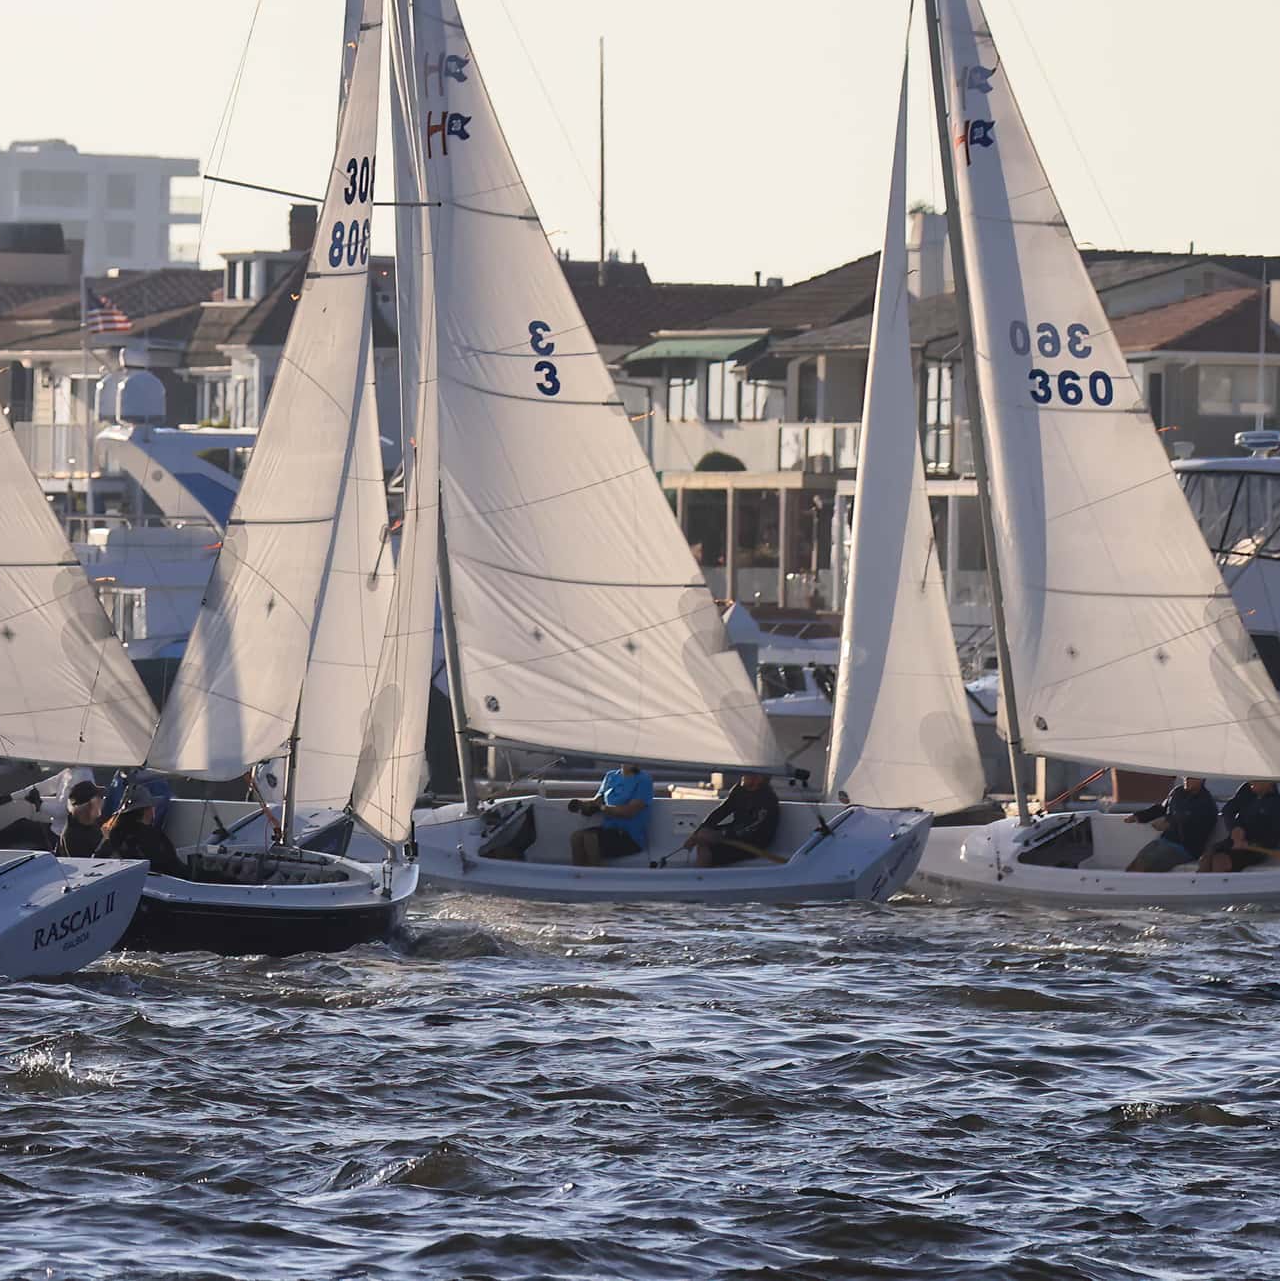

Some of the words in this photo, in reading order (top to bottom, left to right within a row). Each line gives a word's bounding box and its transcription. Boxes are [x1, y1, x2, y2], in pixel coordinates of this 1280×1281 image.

[426, 111, 448, 159] H
[534, 360, 560, 396] 3
[1028, 368, 1114, 406] 360
[32, 900, 101, 951] RASCAL
[105, 890, 117, 914] II
